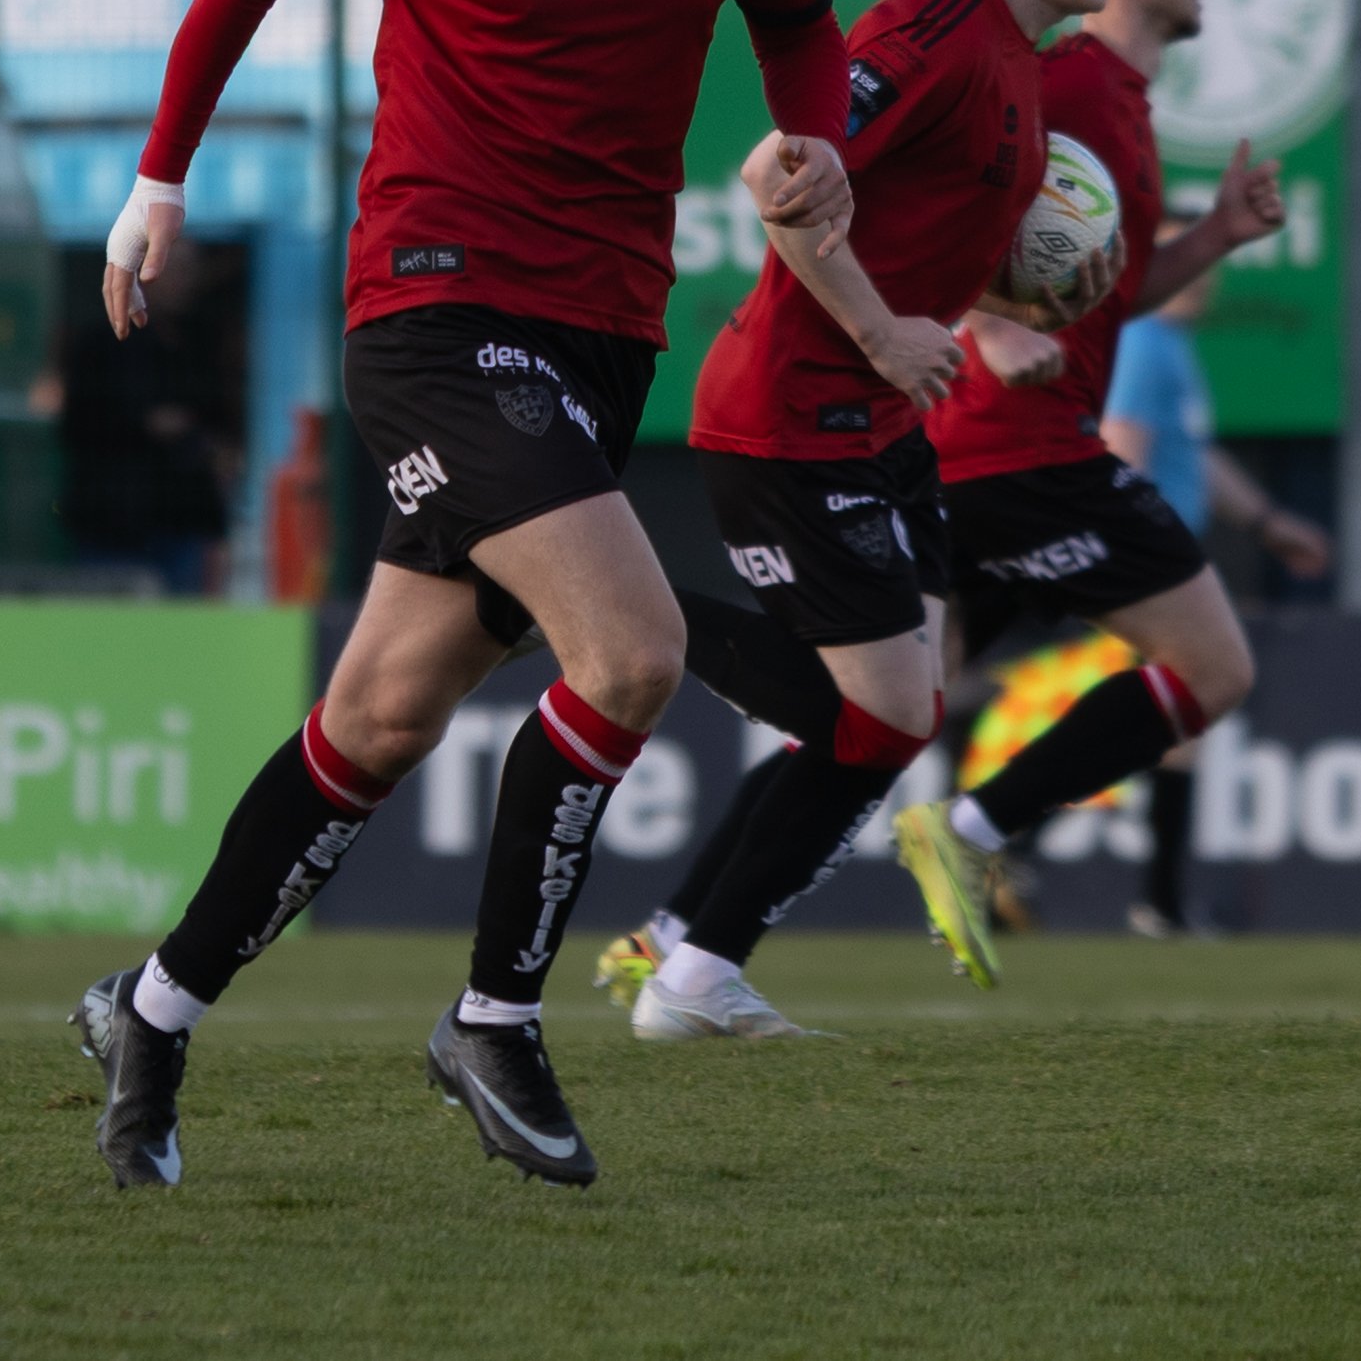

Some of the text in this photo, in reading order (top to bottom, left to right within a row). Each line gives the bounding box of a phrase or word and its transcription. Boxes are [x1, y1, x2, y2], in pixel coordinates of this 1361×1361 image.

[477, 342, 529, 368] des
[387, 445, 449, 516] OKEN
[551, 783, 605, 843] des
[304, 821, 364, 869] des
